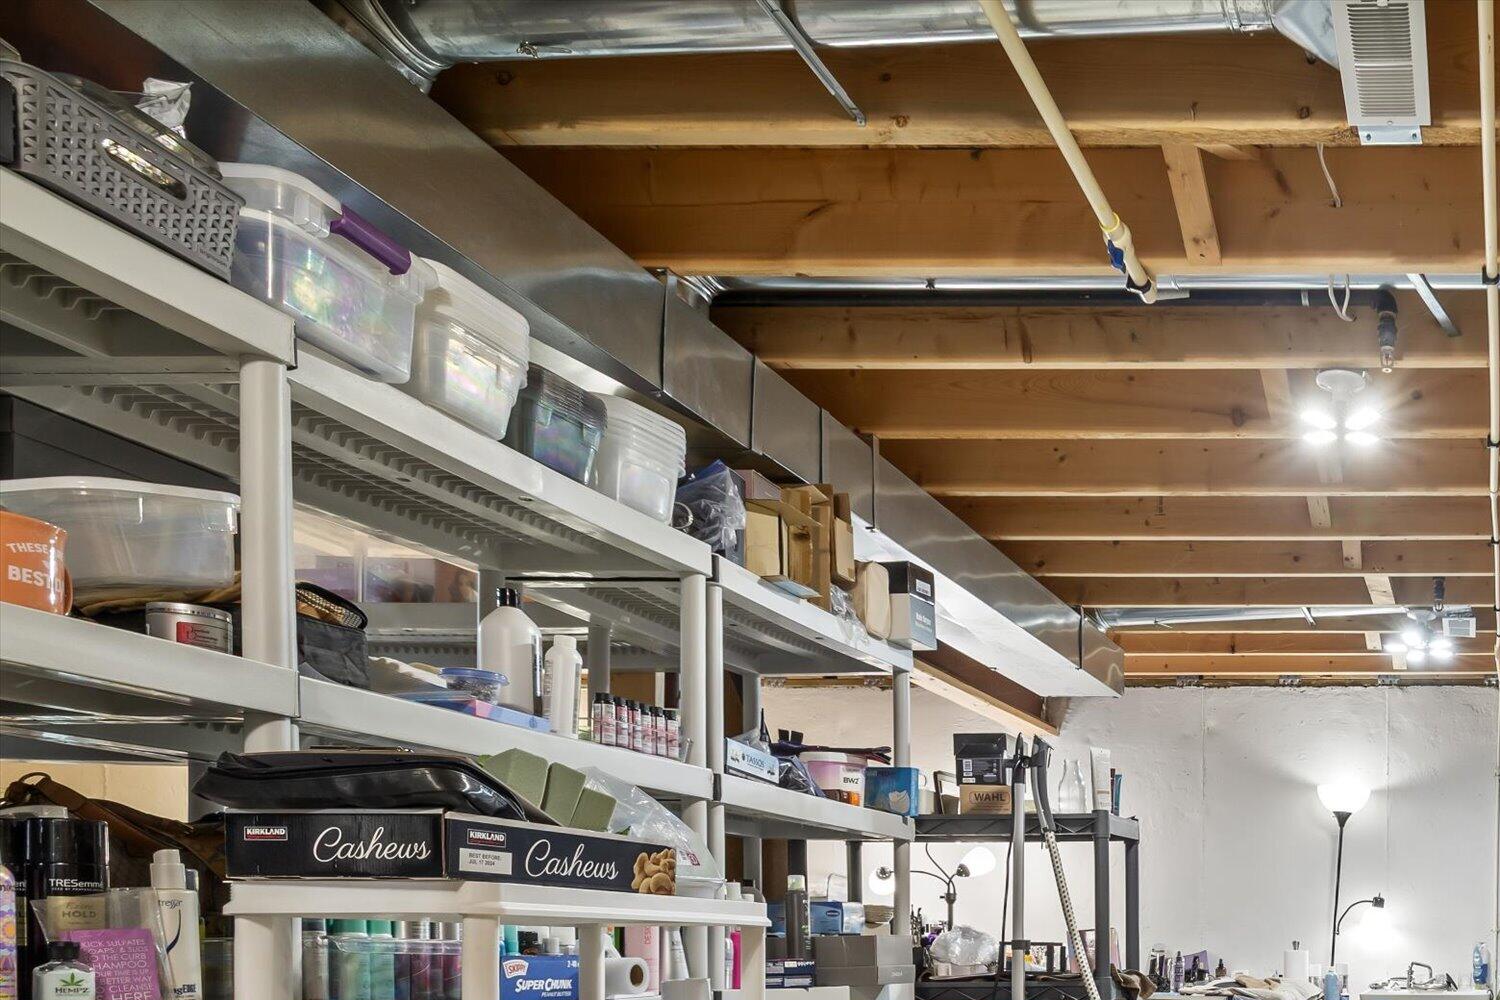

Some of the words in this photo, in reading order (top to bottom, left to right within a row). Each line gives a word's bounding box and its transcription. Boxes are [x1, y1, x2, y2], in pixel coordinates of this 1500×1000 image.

[6, 542, 49, 554] THESE
[8, 564, 51, 590] BEST
[973, 792, 1007, 802] WAHL
[246, 828, 286, 836] KIRKLAND
[469, 831, 505, 842] KIRKLAND
[313, 826, 432, 863] Cashews
[525, 839, 619, 880] Cashews
[62, 909, 98, 919] HOLD
[80, 941, 103, 950] KICK
[120, 953, 147, 961] CURB
[92, 960, 149, 970] HAMPOO.
[55, 986, 91, 995] HEMPZ
[515, 979, 544, 993] SUPER
[545, 978, 572, 991] CHUNK
